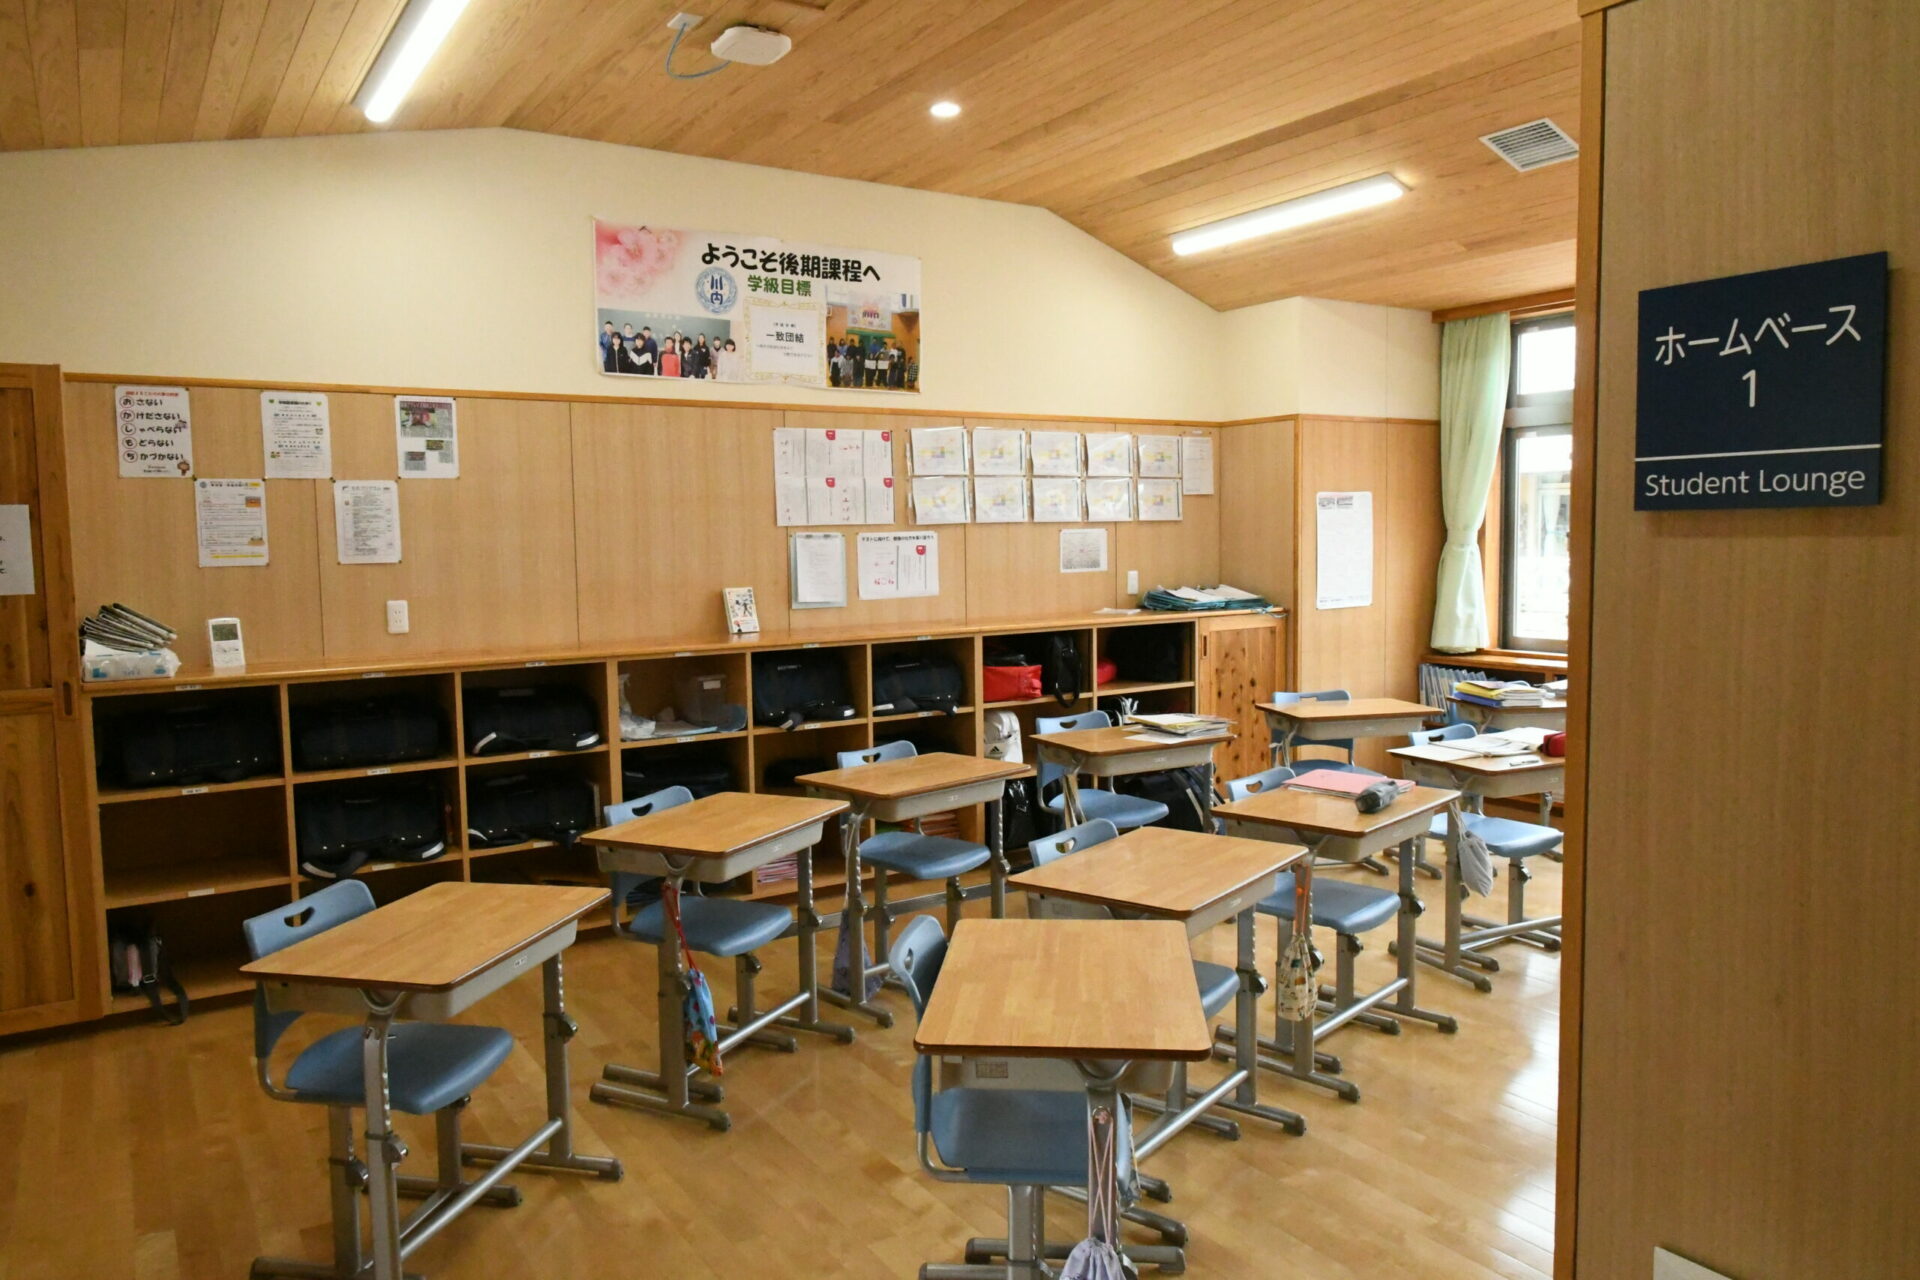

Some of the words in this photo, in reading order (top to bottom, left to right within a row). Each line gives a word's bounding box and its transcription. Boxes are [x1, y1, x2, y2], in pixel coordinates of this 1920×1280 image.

[701, 242, 881, 283] ようこそ後期課程へ
[710, 275, 723, 305] 川内
[747, 274, 812, 297] 学級目標
[766, 331, 804, 344] 一致団結
[1654, 304, 1862, 366] ホームベース
[1741, 369, 1757, 408] 1
[1645, 470, 1750, 497] Student
[1759, 469, 1865, 498] Lounge
